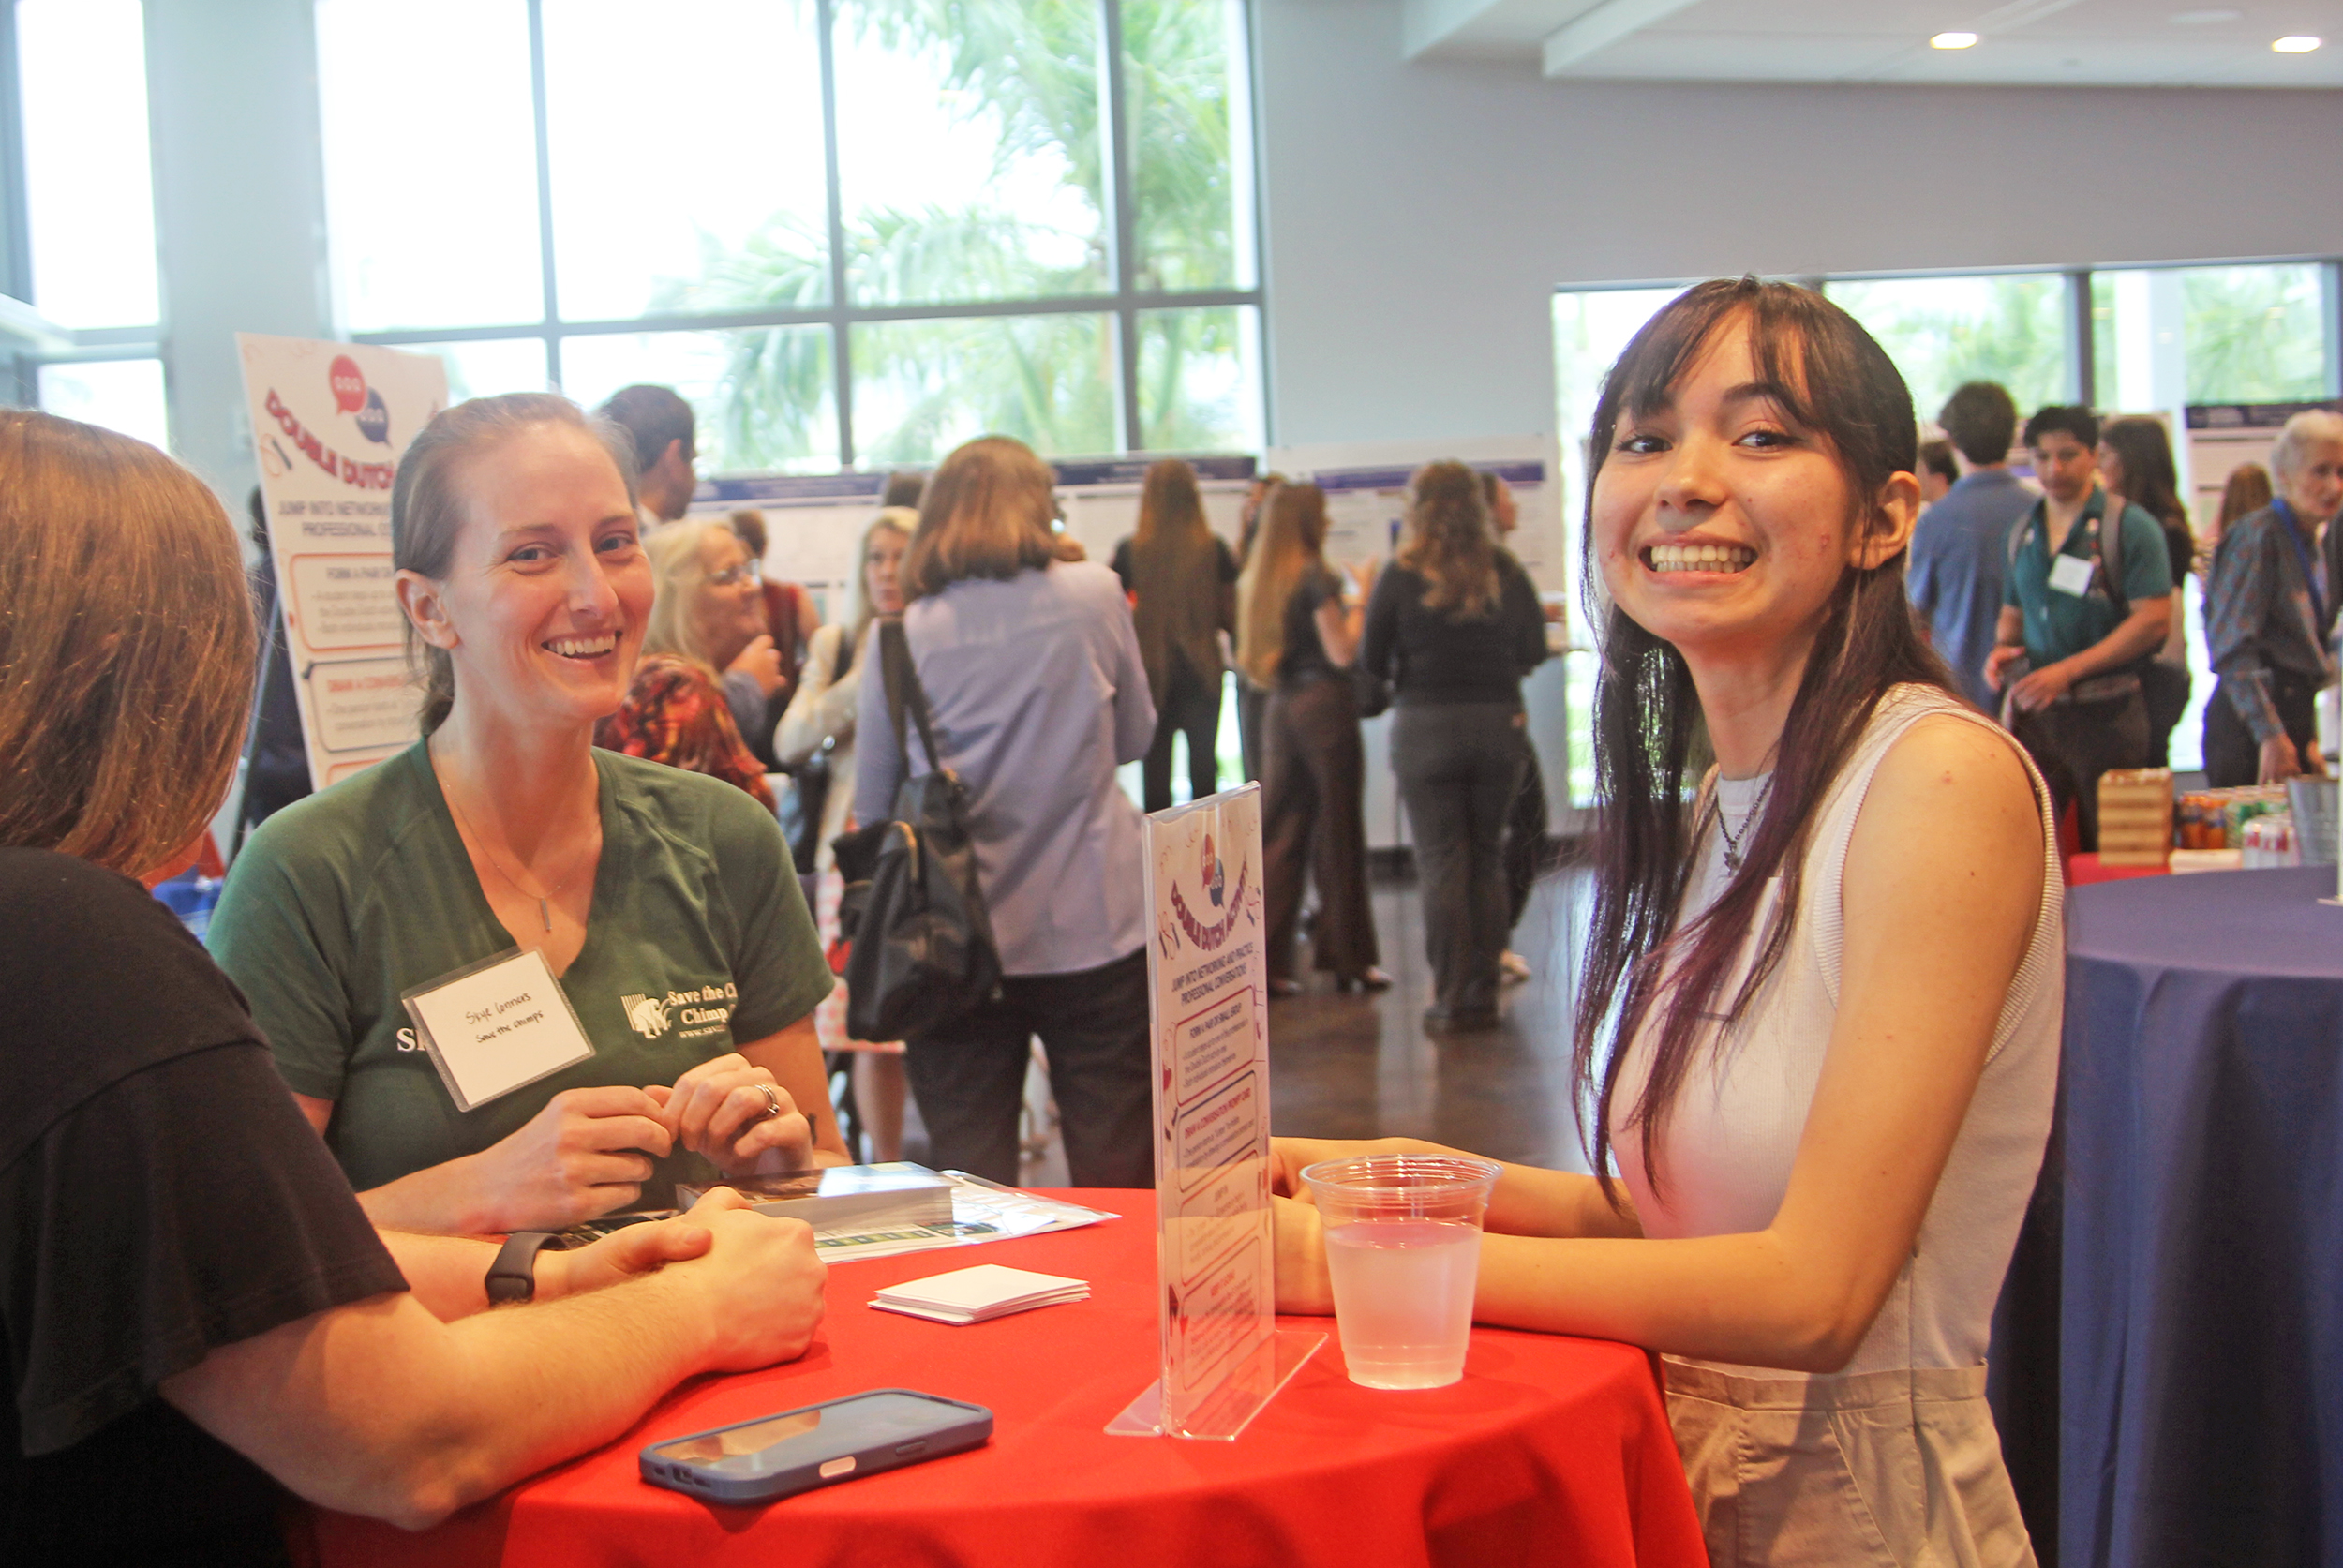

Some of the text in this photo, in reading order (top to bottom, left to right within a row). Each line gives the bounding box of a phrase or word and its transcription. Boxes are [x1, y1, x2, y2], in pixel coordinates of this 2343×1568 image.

[667, 990, 701, 1007] Save
[702, 985, 724, 1002] the
[465, 1008, 492, 1025] Skye
[476, 1031, 497, 1043] Save
[496, 1025, 512, 1035] the
